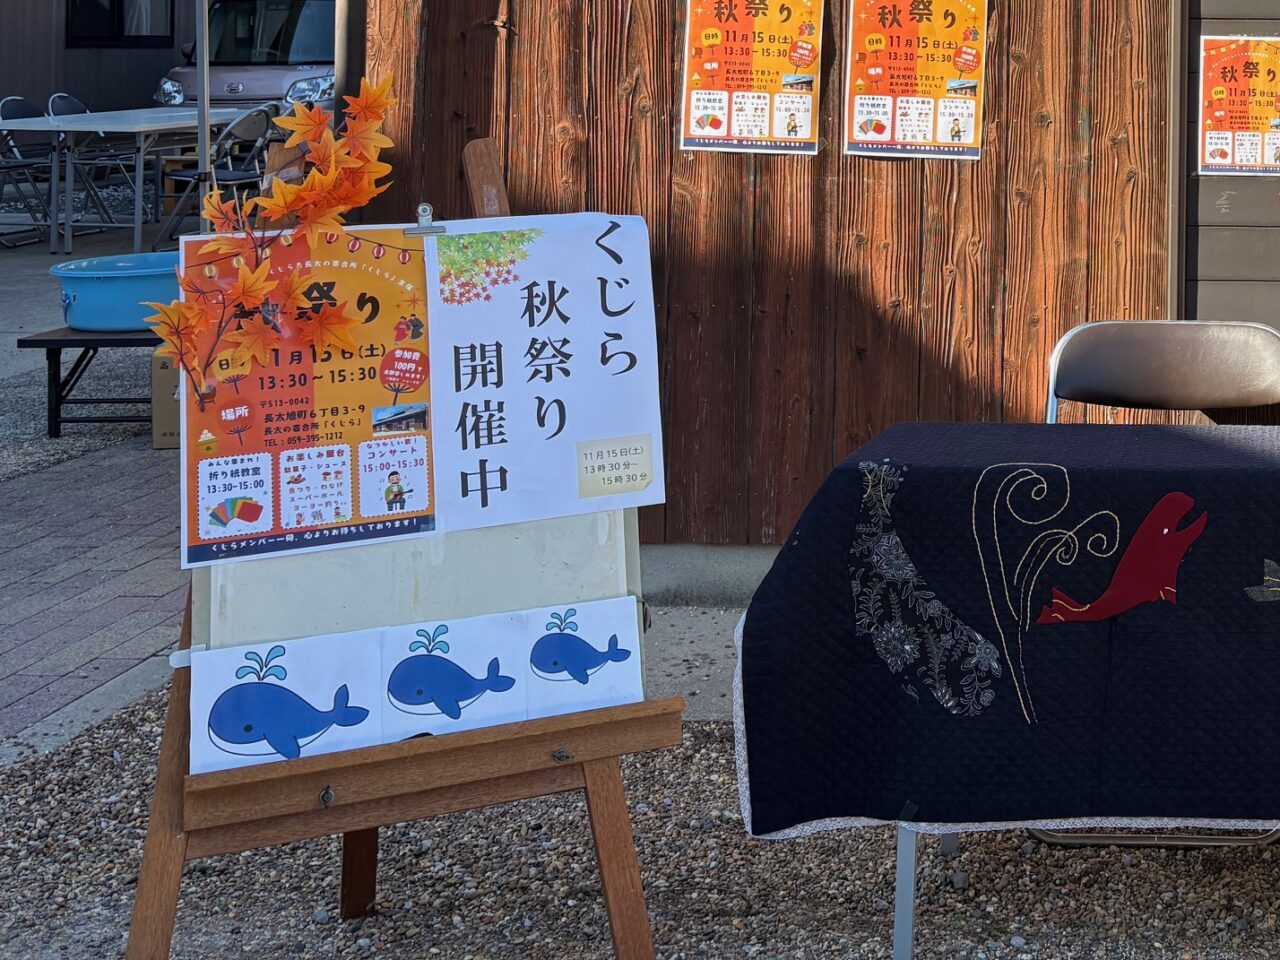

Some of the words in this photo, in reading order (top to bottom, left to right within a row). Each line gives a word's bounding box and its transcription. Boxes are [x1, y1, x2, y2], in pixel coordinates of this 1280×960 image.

[878, 0, 956, 29] 秋祭り
[725, 30, 793, 44] 11月15日(土)
[889, 35, 958, 50] 11月15日(土)
[1220, 61, 1276, 83] 秋祭り
[595, 220, 638, 376] くじら
[519, 280, 574, 441] 秋祭り
[221, 405, 249, 421] 場所
[453, 341, 509, 508] 開催中
[286, 449, 345, 463] お楽しみ屋台
[367, 446, 418, 460] コンサート
[208, 466, 261, 482] 折り紙教室
[601, 472, 648, 486] 15時30分
